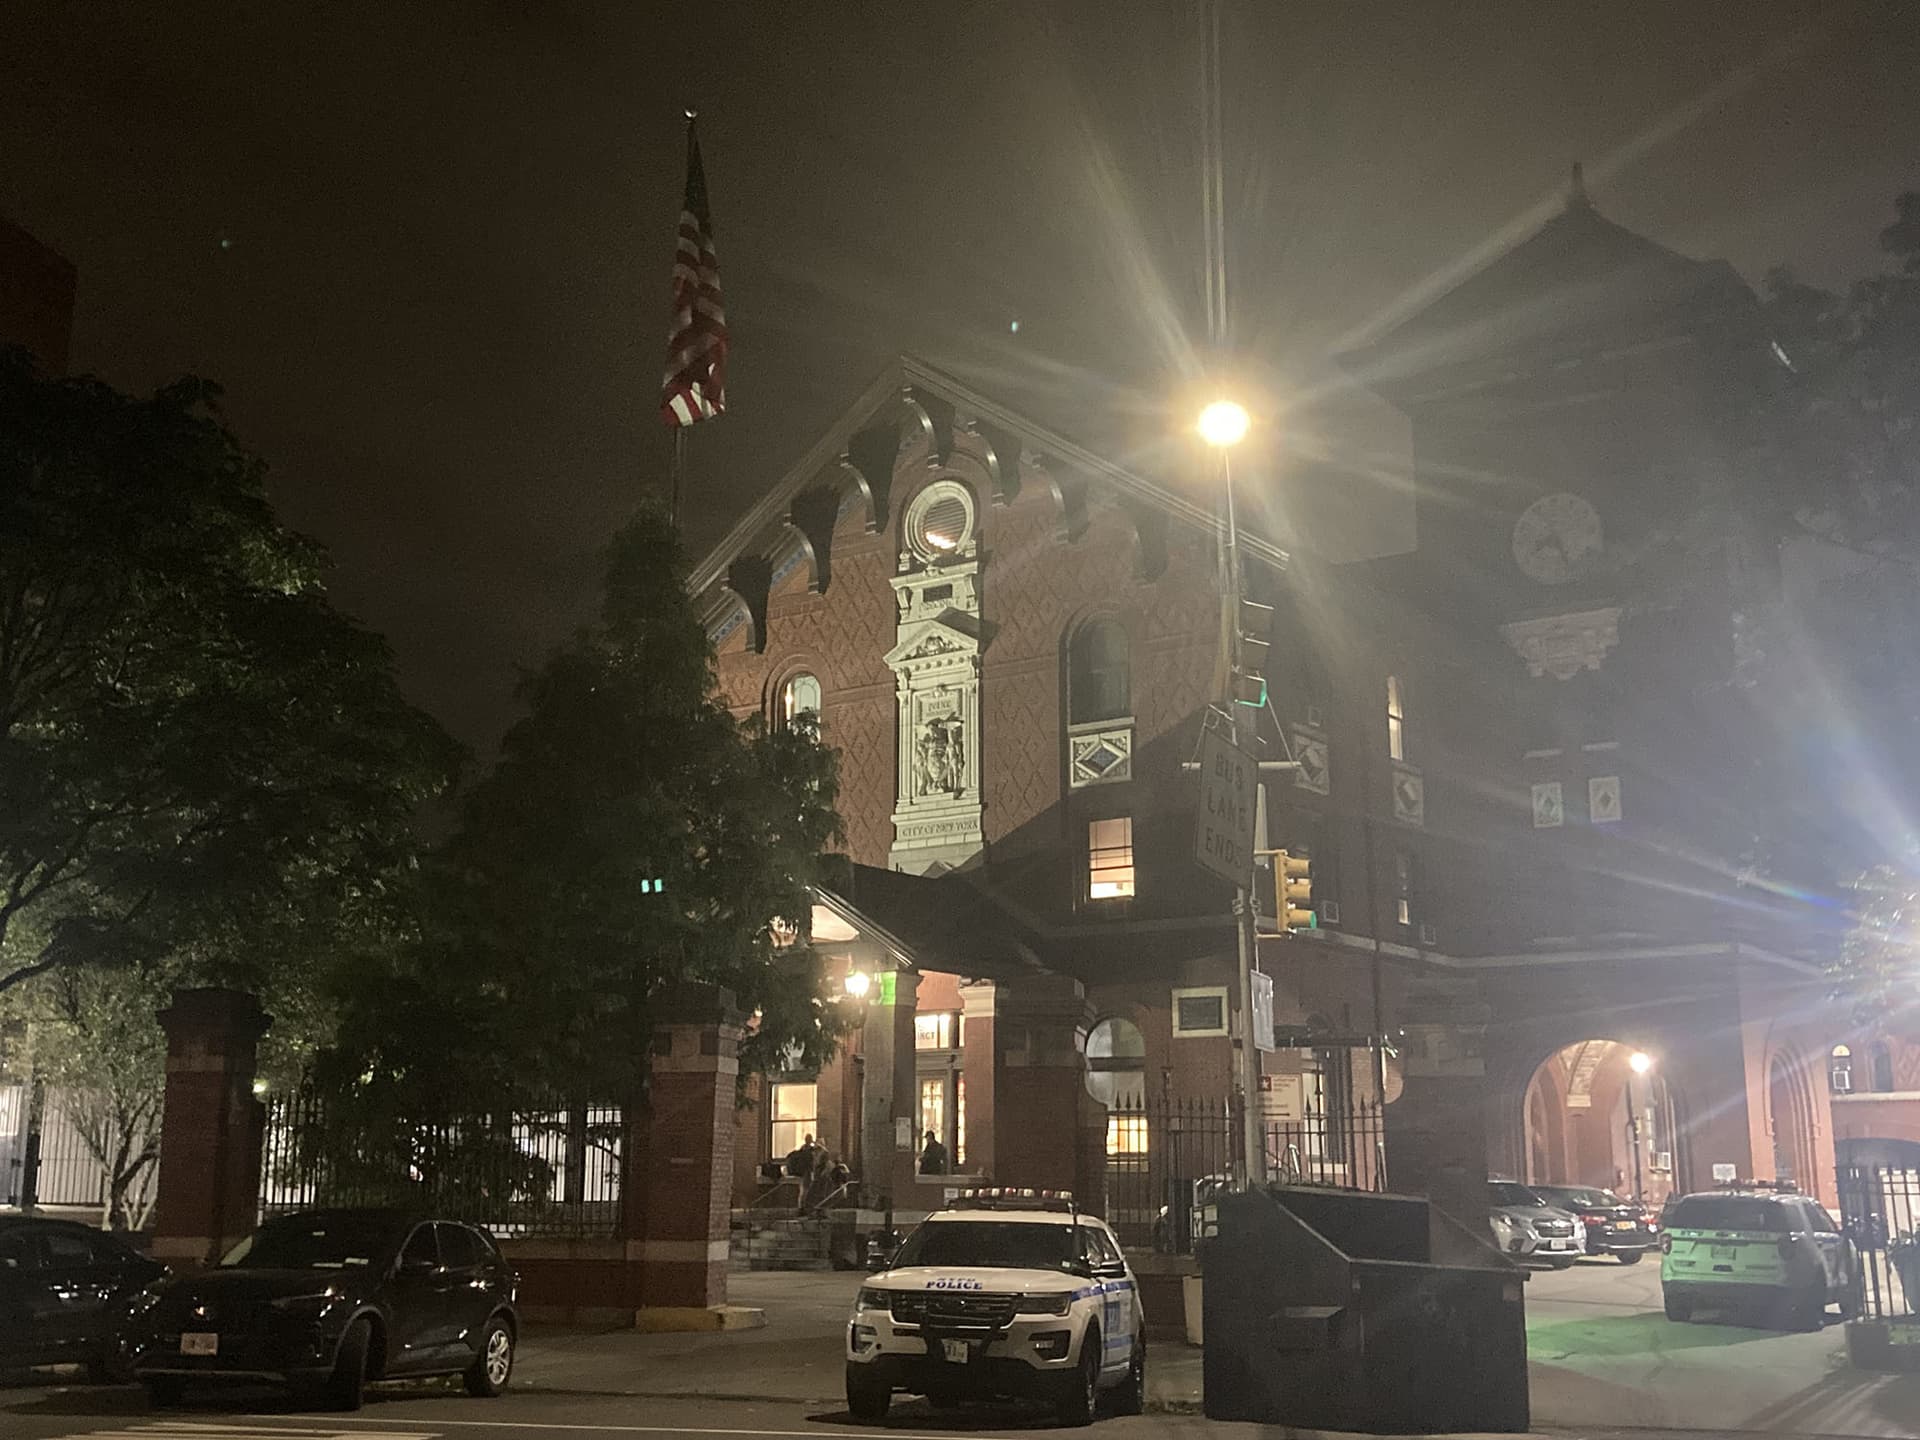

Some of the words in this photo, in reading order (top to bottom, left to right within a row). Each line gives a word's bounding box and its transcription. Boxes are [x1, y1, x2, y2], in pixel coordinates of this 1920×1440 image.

[1215, 752, 1243, 791] BUS
[1207, 786, 1246, 833] LANE
[1205, 826, 1243, 870] ENDS
[926, 1281, 983, 1290] POLICE
